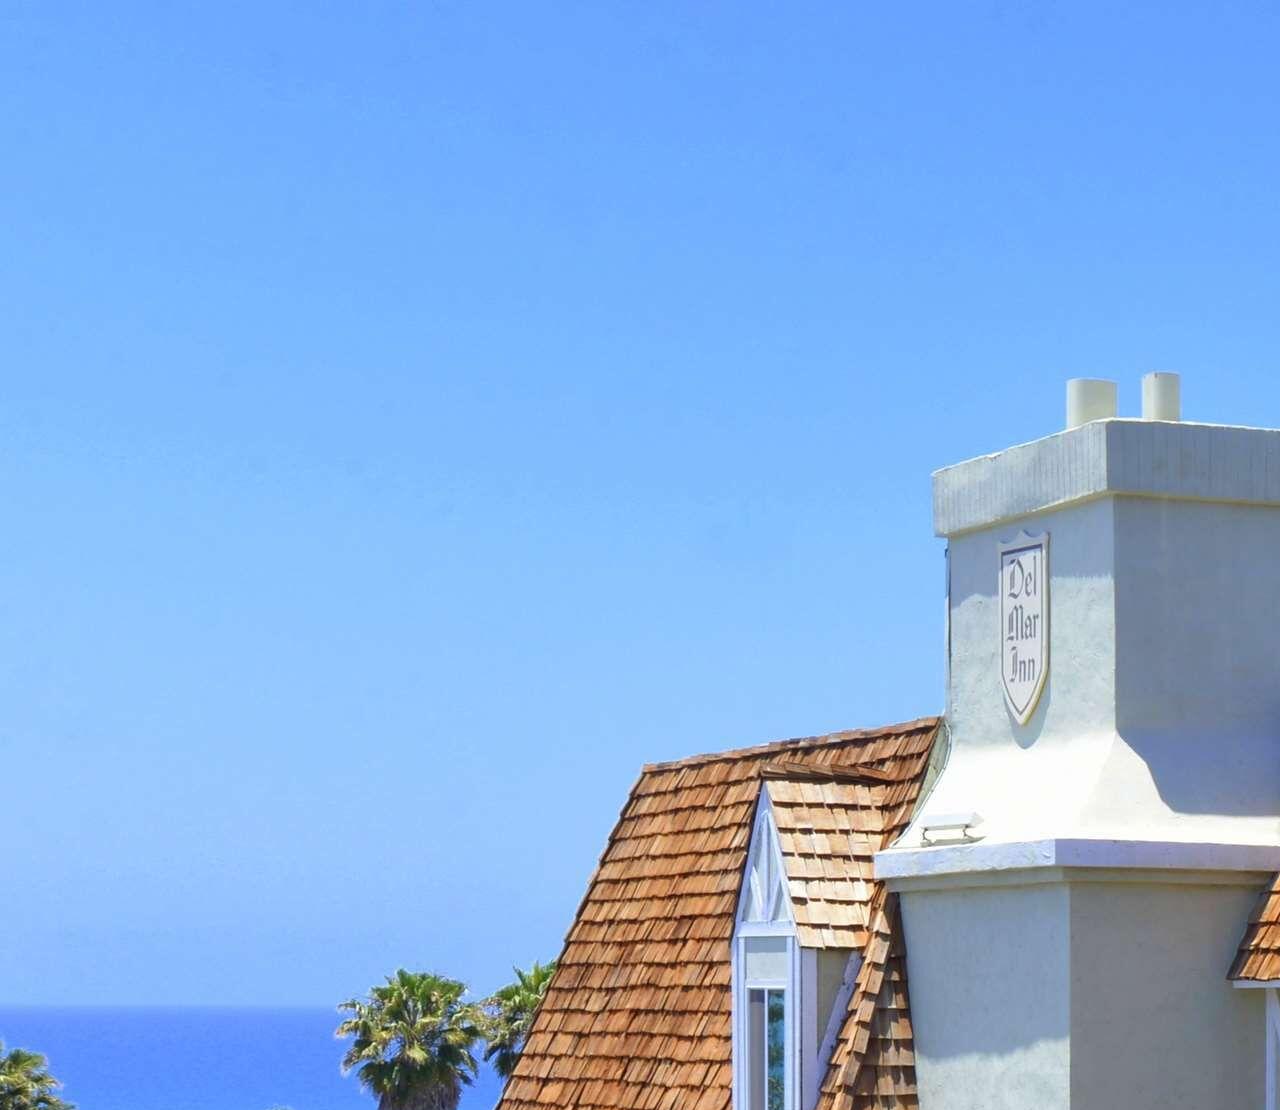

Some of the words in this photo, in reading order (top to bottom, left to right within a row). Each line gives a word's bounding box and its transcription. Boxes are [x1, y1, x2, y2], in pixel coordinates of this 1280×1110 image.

[1008, 555, 1037, 599] Del
[1007, 604, 1039, 641] Mar
[1009, 646, 1036, 683] Inn
